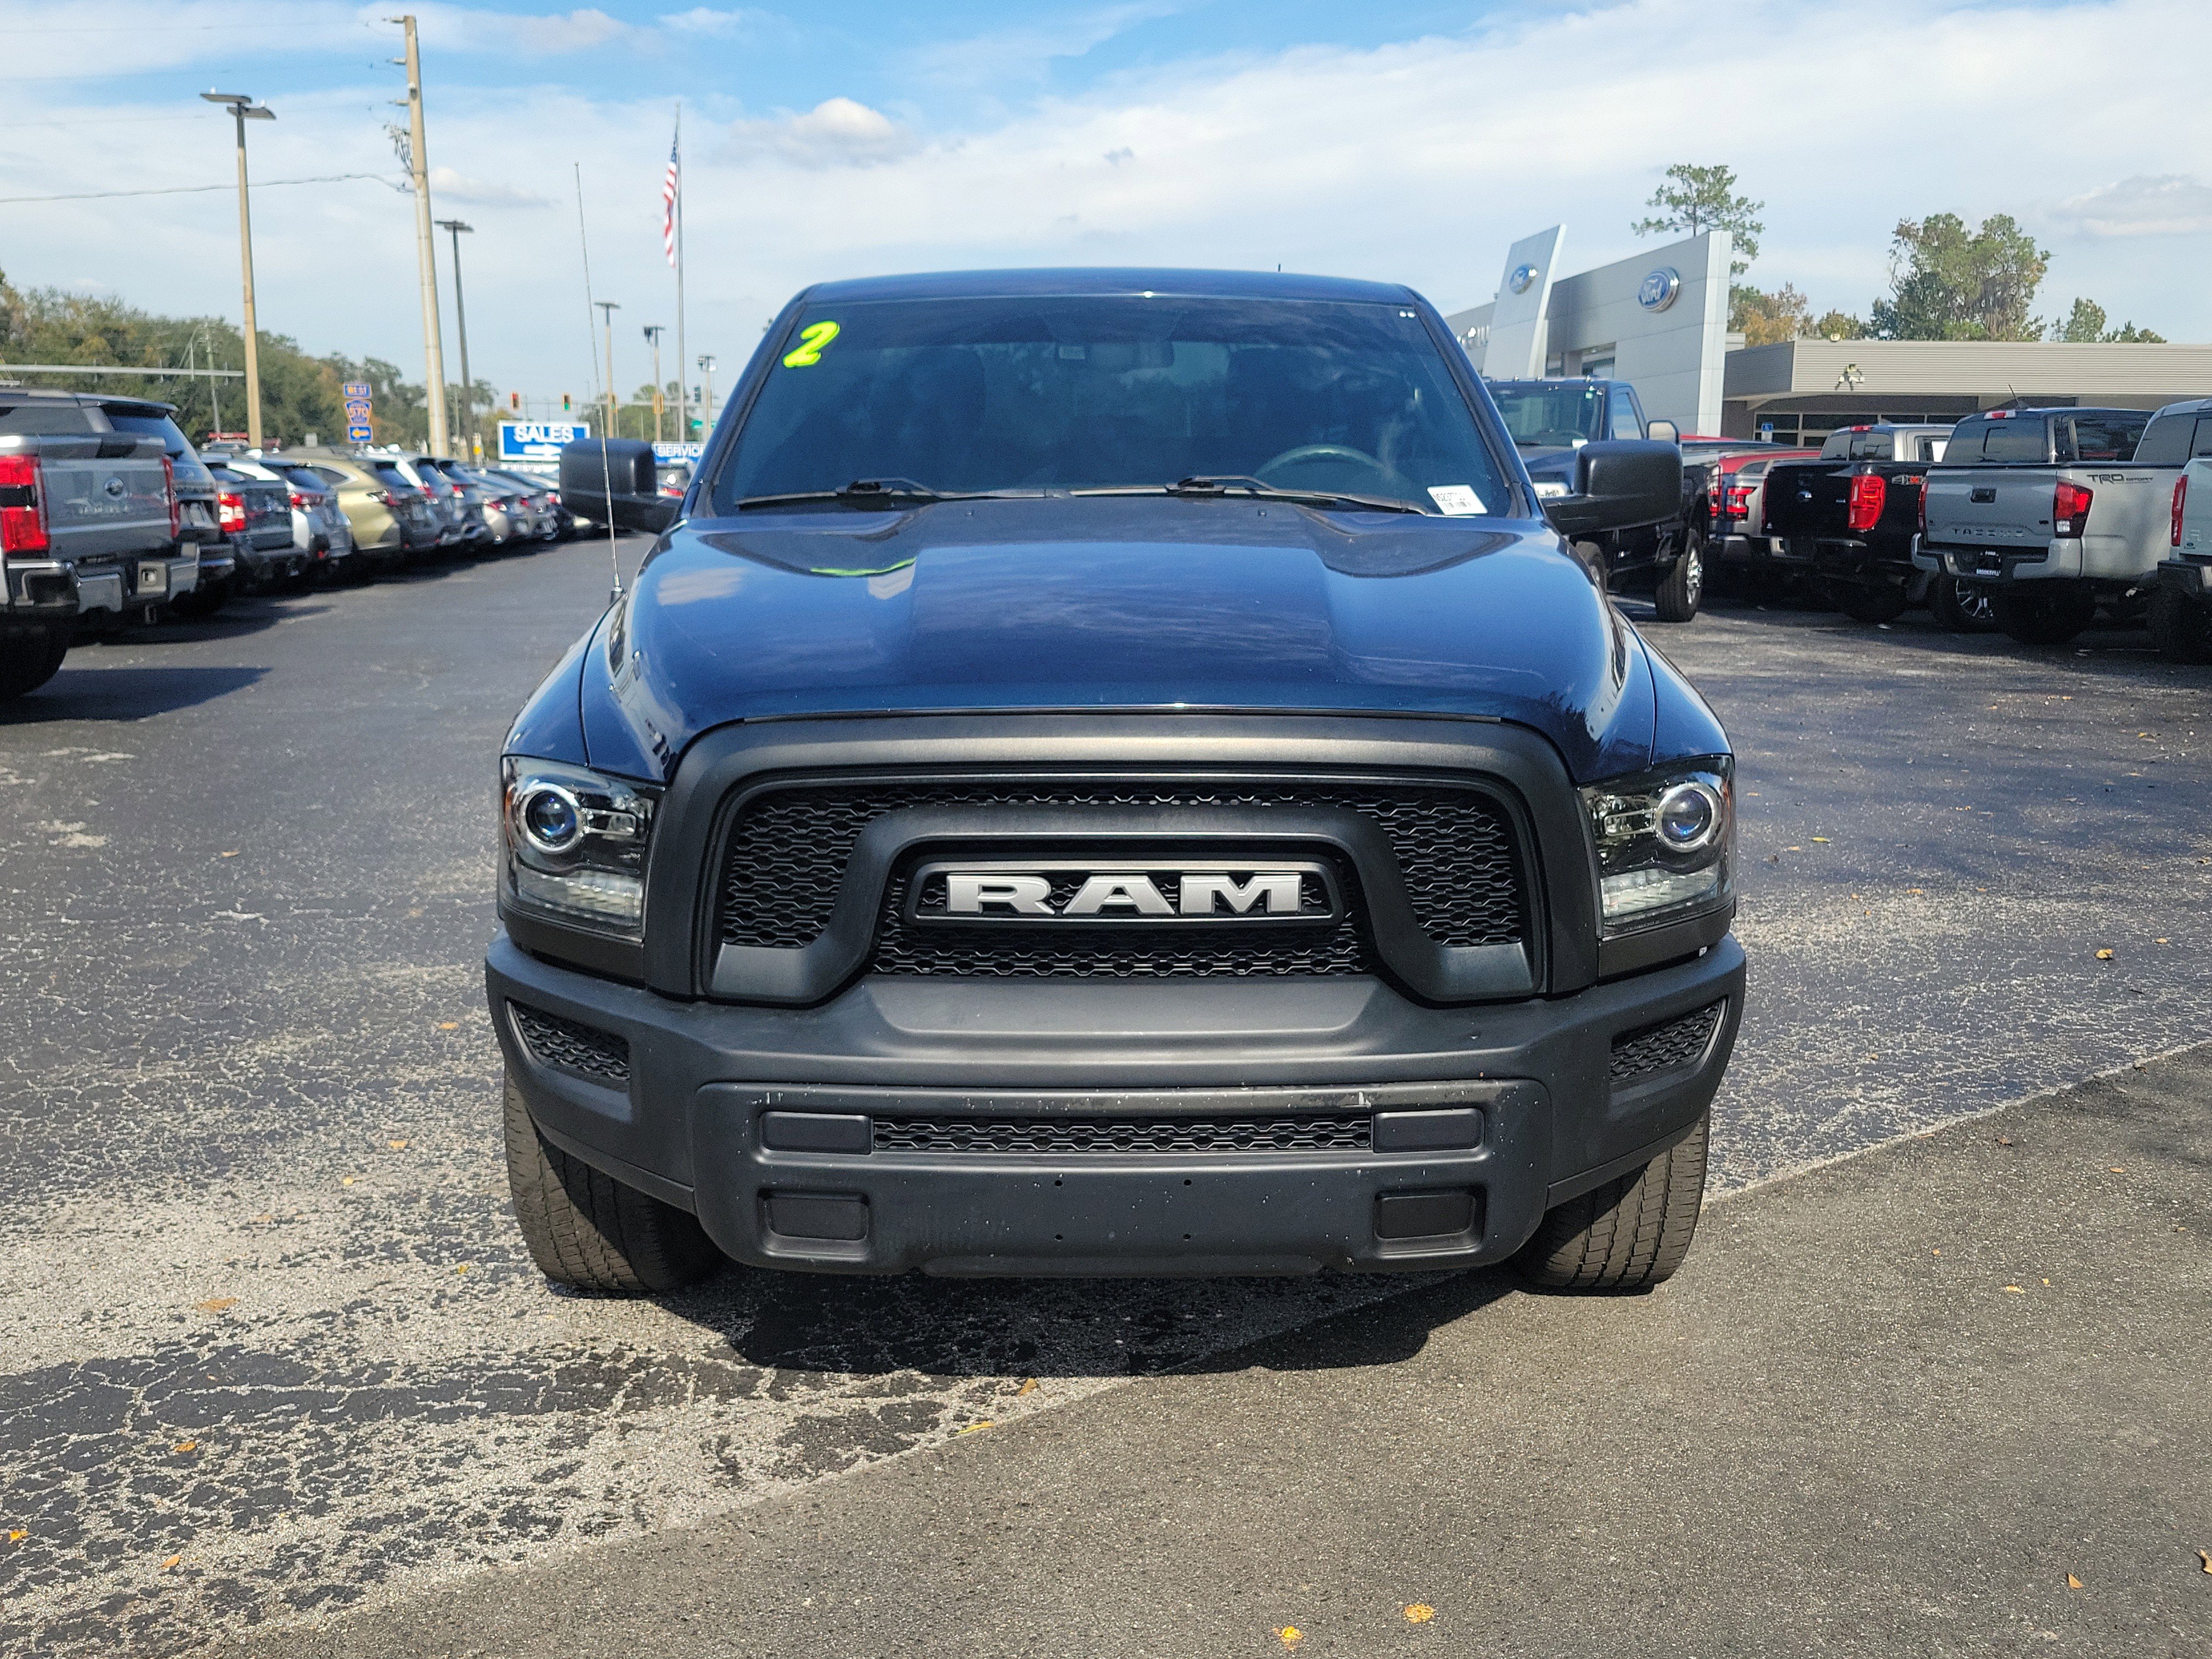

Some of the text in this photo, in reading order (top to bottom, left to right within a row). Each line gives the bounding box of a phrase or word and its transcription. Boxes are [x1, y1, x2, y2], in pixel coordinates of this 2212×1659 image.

[1641, 279, 1663, 304] Ford
[783, 320, 840, 368] 2
[514, 424, 574, 443] SALES
[2086, 474, 2125, 485] TRD
[946, 874, 1302, 915] RAM
